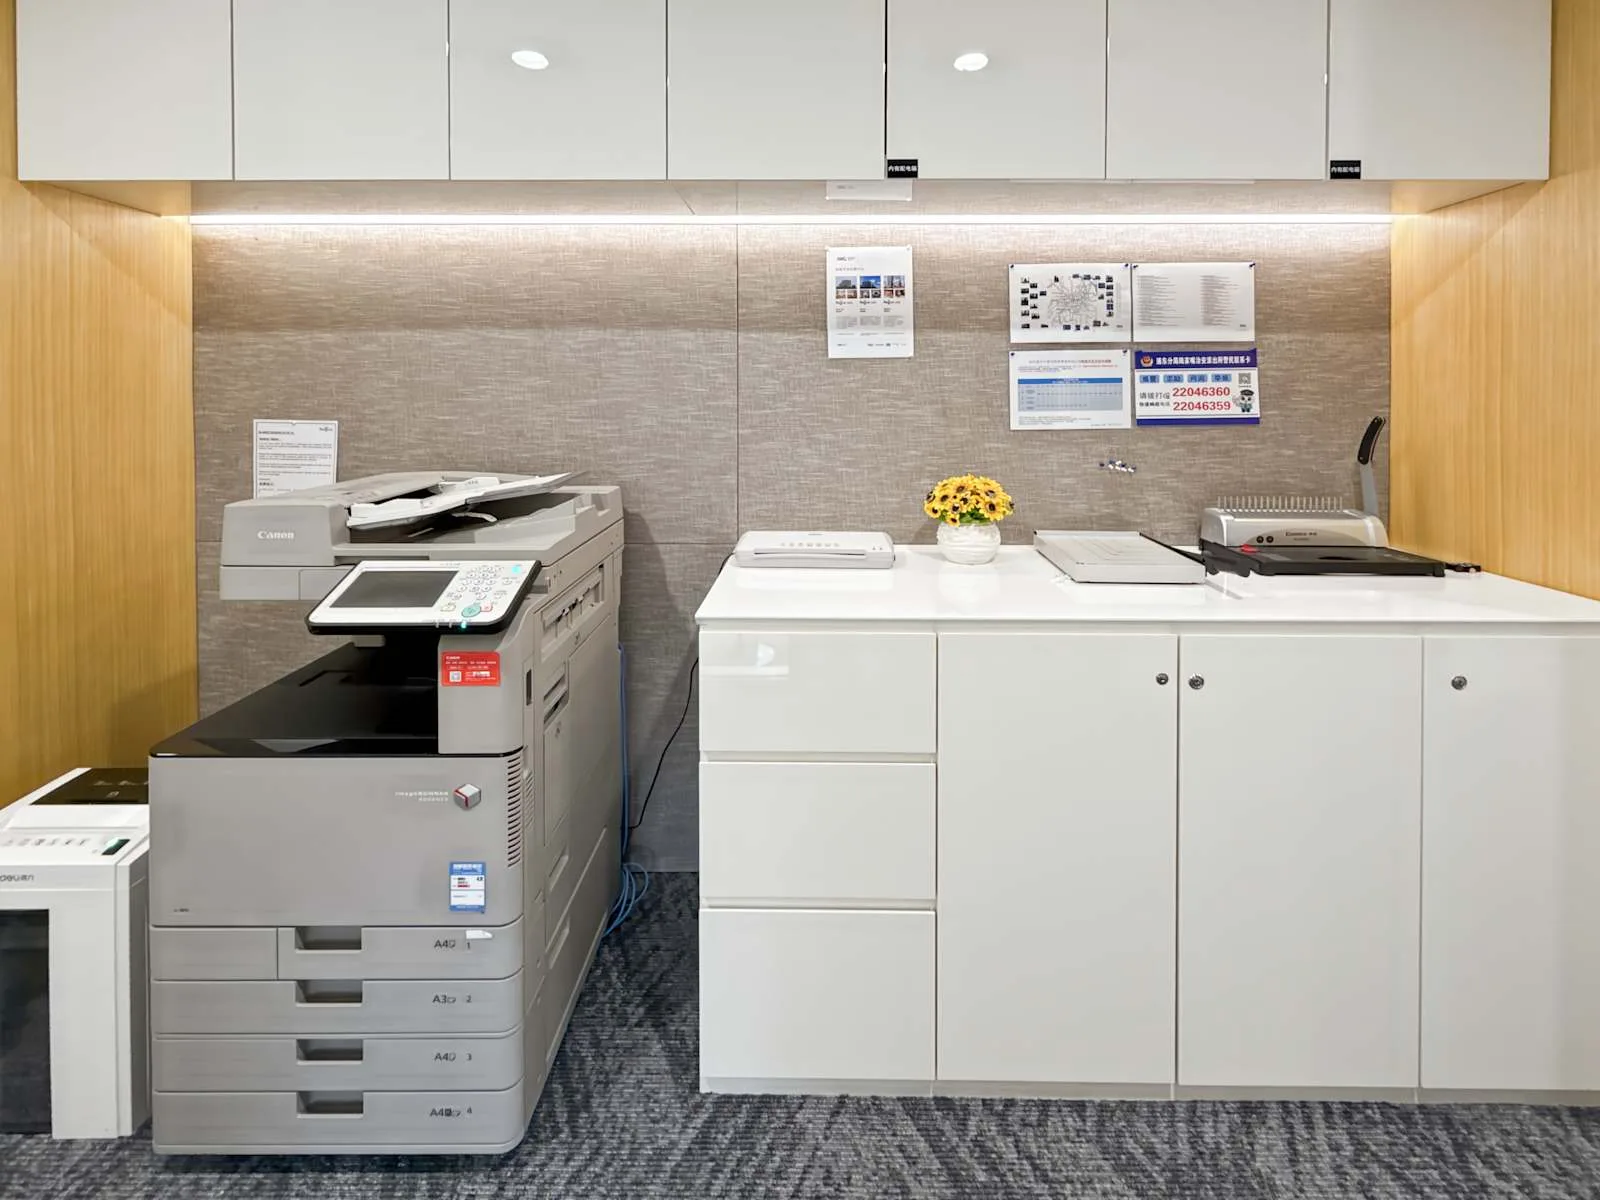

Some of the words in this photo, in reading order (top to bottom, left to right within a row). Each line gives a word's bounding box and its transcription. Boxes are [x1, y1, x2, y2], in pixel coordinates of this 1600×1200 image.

[1172, 386, 1231, 397] 22046360
[1173, 401, 1231, 411] 22046359
[257, 530, 294, 540] Canon
